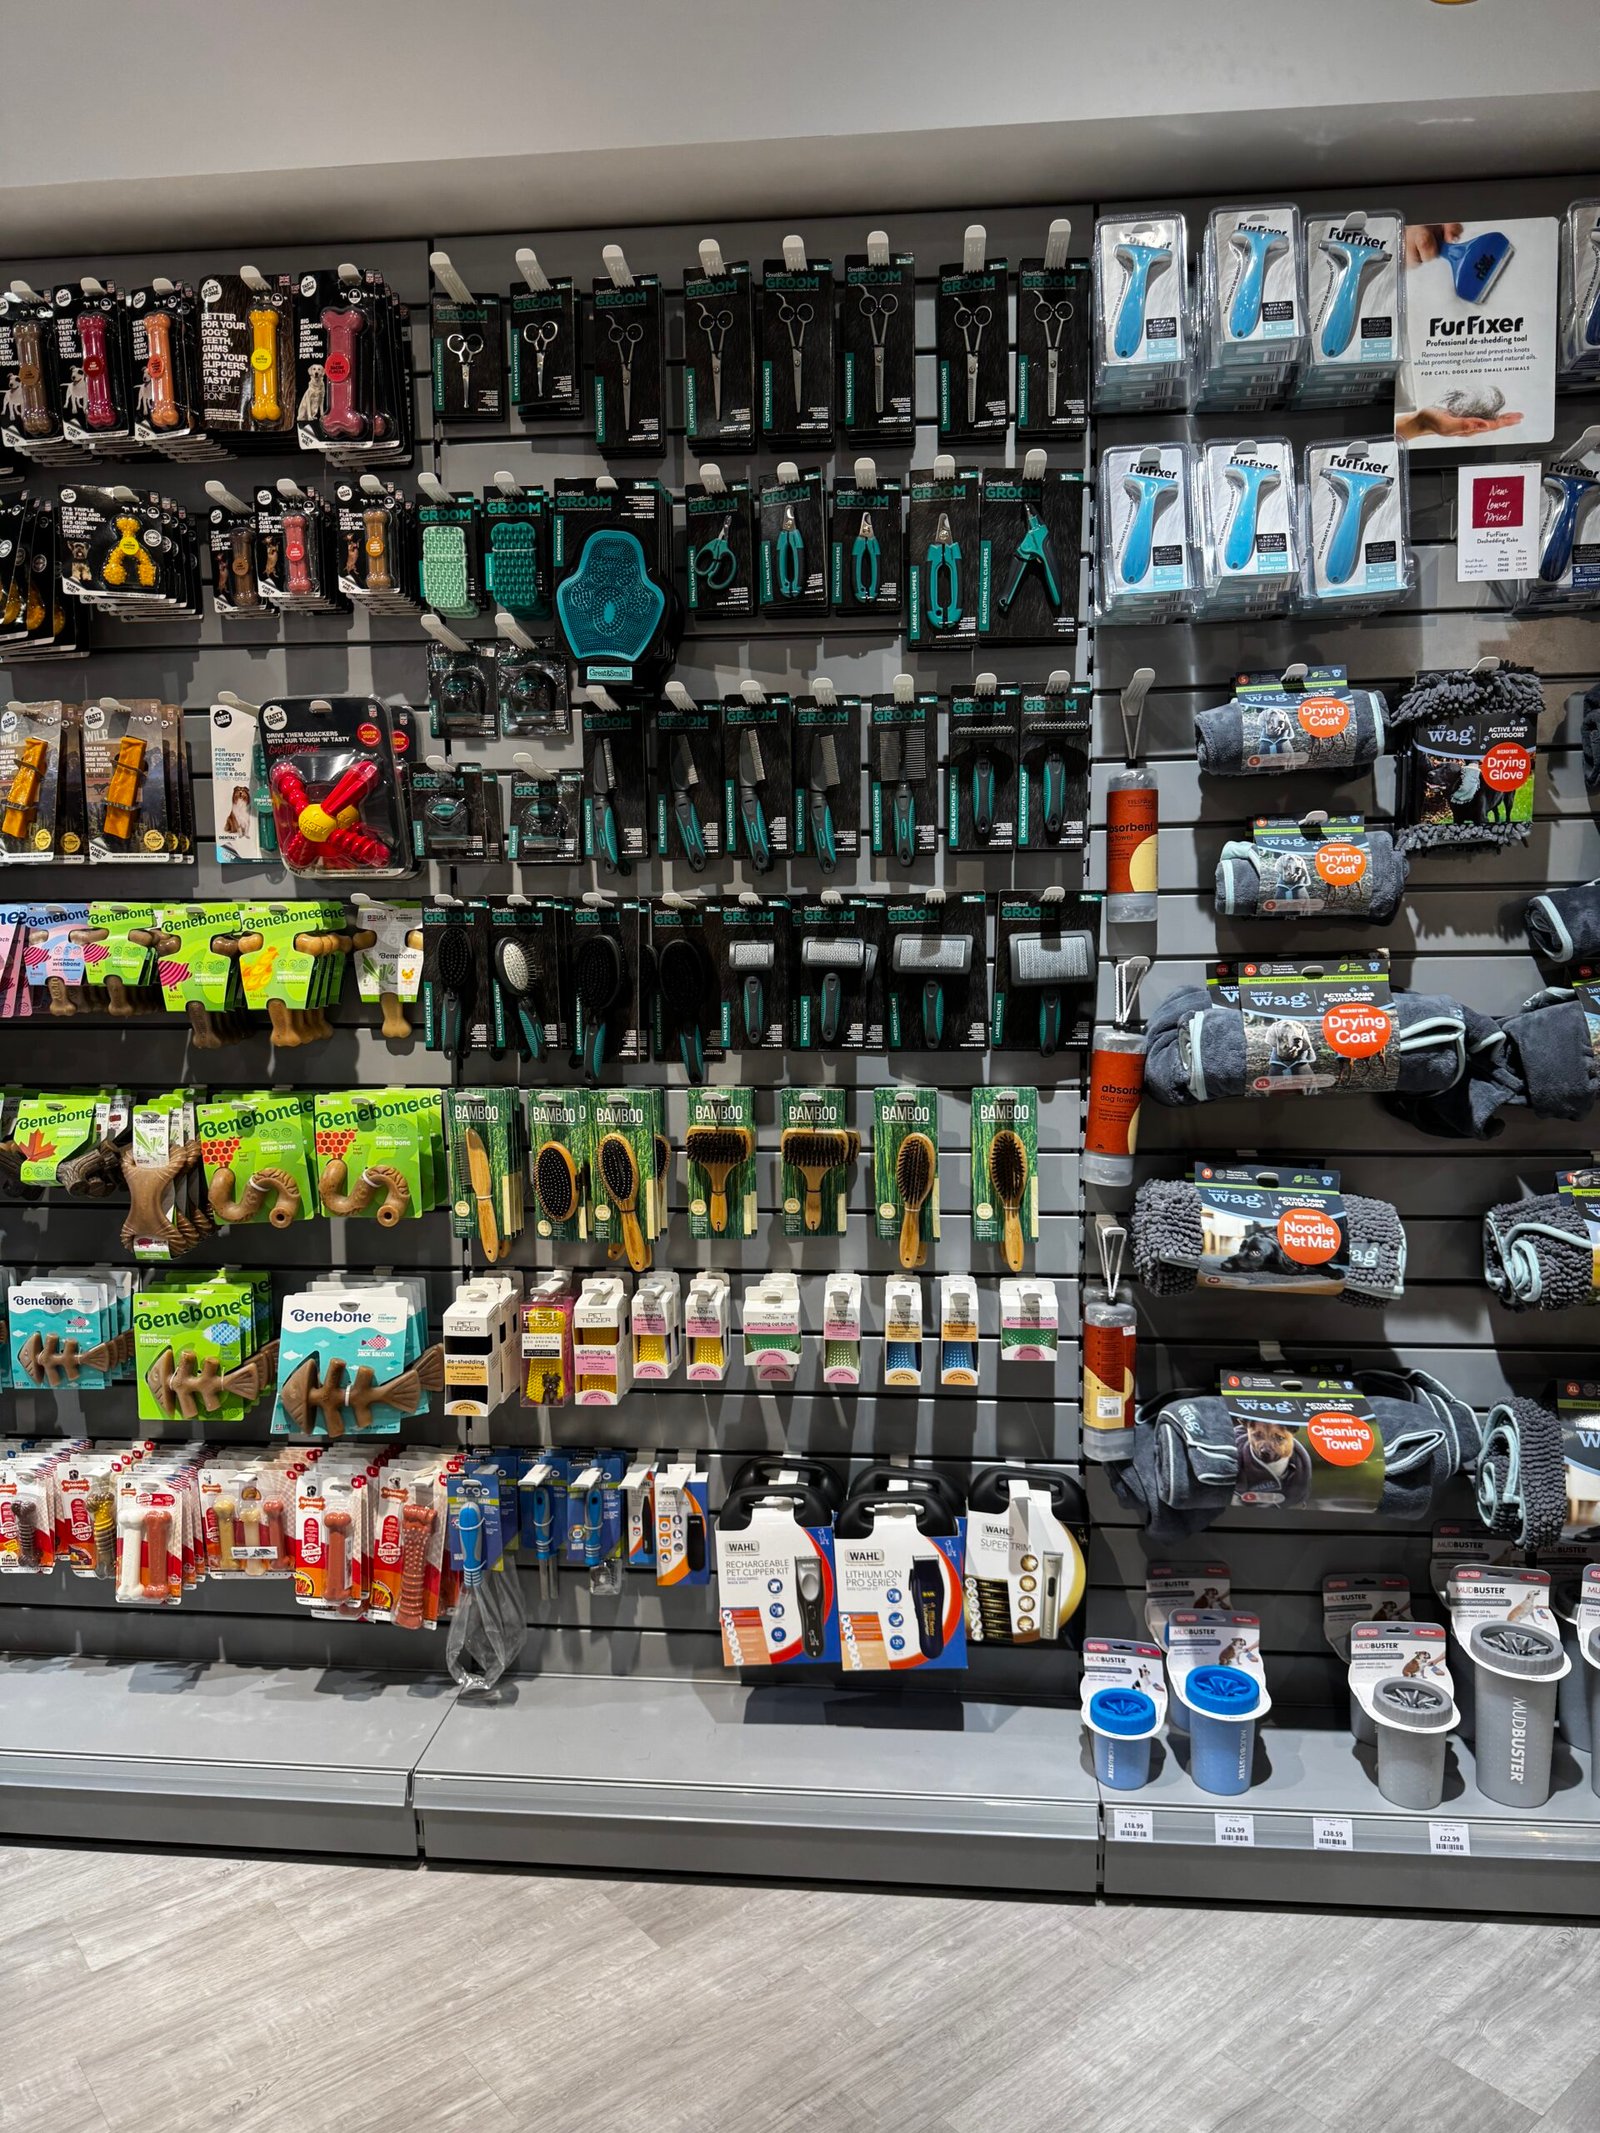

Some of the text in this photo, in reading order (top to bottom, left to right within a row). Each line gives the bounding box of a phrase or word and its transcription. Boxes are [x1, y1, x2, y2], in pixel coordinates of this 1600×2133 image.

[848, 271, 902, 282] GROOM
[766, 277, 819, 288] GROOM
[221, 322, 246, 330] YOUR
[1430, 316, 1524, 336] FurFixer
[202, 337, 233, 346] TEETH,
[1426, 338, 1468, 347] Professional
[1469, 336, 1512, 346] de-shedding
[202, 345, 228, 353] GUMS
[1488, 348, 1512, 356] prevents
[223, 354, 247, 362] YOUR
[1432, 359, 1460, 367] promoting
[203, 361, 248, 371] SLIPPERS,
[204, 377, 231, 385] TASTY
[204, 385, 239, 393] FLEXIBLE
[1330, 455, 1390, 474] FurFixer
[1129, 463, 1177, 479] FurFixer
[763, 486, 810, 504] GROOM
[912, 485, 966, 498] GROOM
[1489, 485, 1508, 496] New
[558, 497, 611, 507] GROOM
[1487, 499, 1510, 511] Lower
[487, 503, 540, 514] GROOM
[1484, 511, 1512, 523] Price!
[589, 668, 628, 677] Great&Small
[953, 701, 1006, 713] GROOM
[1024, 699, 1077, 711] GROOM
[265, 711, 283, 722] TASTY
[727, 710, 777, 720] GROOM
[1302, 706, 1344, 716] Drying
[268, 717, 284, 725] BONE
[1310, 716, 1339, 726] Coat
[1487, 757, 1526, 769] Drying
[1489, 769, 1523, 780] Glove
[1320, 853, 1361, 864] Drying
[1326, 864, 1356, 874] Coat
[26, 909, 90, 927] Benebone
[161, 911, 232, 932] Benebone
[243, 909, 322, 930] Benebone
[424, 912, 474, 922] GROOM
[804, 911, 855, 921] GROOM
[1327, 1015, 1385, 1030] Drying
[1336, 1030, 1377, 1044] Coat
[314, 1098, 418, 1129] Benebone
[455, 1105, 498, 1121] BAMBOO
[533, 1106, 576, 1123] BAMBOO
[597, 1108, 643, 1123] BAMBOO
[696, 1106, 742, 1120] BAMBOO
[789, 1106, 837, 1120] BAMBOO
[882, 1106, 930, 1121] BAMBOO
[980, 1105, 1029, 1120] BAMBOO
[16, 1108, 94, 1131] Benebone
[199, 1103, 301, 1138] Benebone
[261, 1143, 296, 1152] tripe bone
[376, 1139, 393, 1147] tripe
[1284, 1221, 1334, 1235] Noodle
[1283, 1234, 1336, 1250] Pet Mat
[13, 1295, 74, 1306] Benebone
[134, 1302, 240, 1331] Benebone
[291, 1308, 373, 1323] Benebone
[523, 1311, 556, 1321] PET
[1311, 1426, 1370, 1439] Cleaning
[1323, 1437, 1362, 1450] Towel
[456, 1486, 490, 1497] ergo
[986, 1525, 1012, 1535] WAHL
[729, 1543, 755, 1552] WAHL
[981, 1539, 1031, 1552] SUPER TRIM
[850, 1552, 880, 1560] WAHL
[726, 1559, 789, 1568] RECHARGEABLE
[738, 1568, 774, 1576] CLIPPER
[845, 1570, 879, 1578] LITHIUM
[1456, 1586, 1506, 1595] MUDBUSTER
[1173, 1628, 1216, 1636] MUDBUSTER
[1086, 1656, 1127, 1664] MUDBUSTER
[1511, 1696, 1527, 1784] MUDBUSTER
[1225, 1826, 1245, 1834] £26.99
[1440, 1835, 1460, 1843] £22.99
